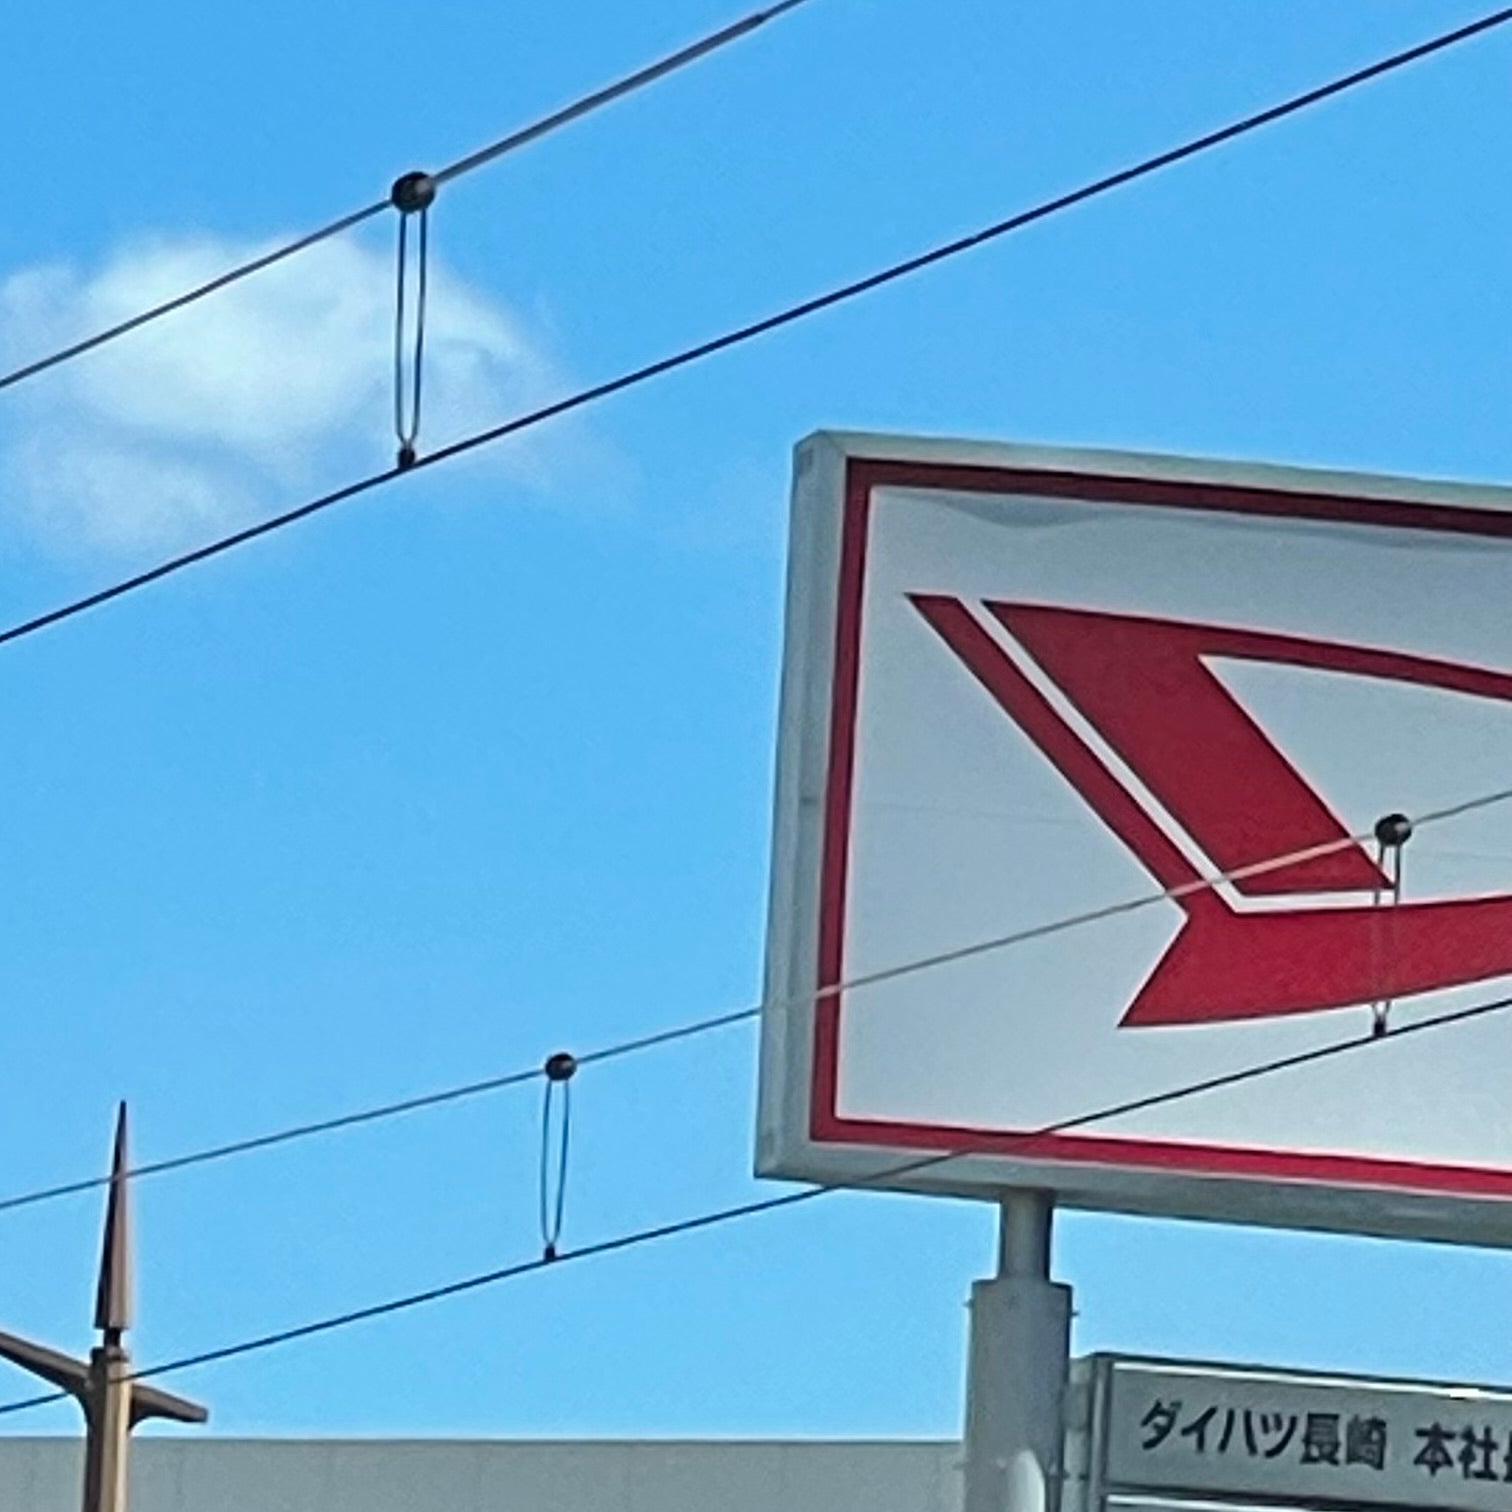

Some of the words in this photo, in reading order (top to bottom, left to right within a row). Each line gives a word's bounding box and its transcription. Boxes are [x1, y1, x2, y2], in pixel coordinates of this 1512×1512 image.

[1140, 1399, 1387, 1471] ダイハツ長崎
[1413, 1421, 1512, 1483] 本社
